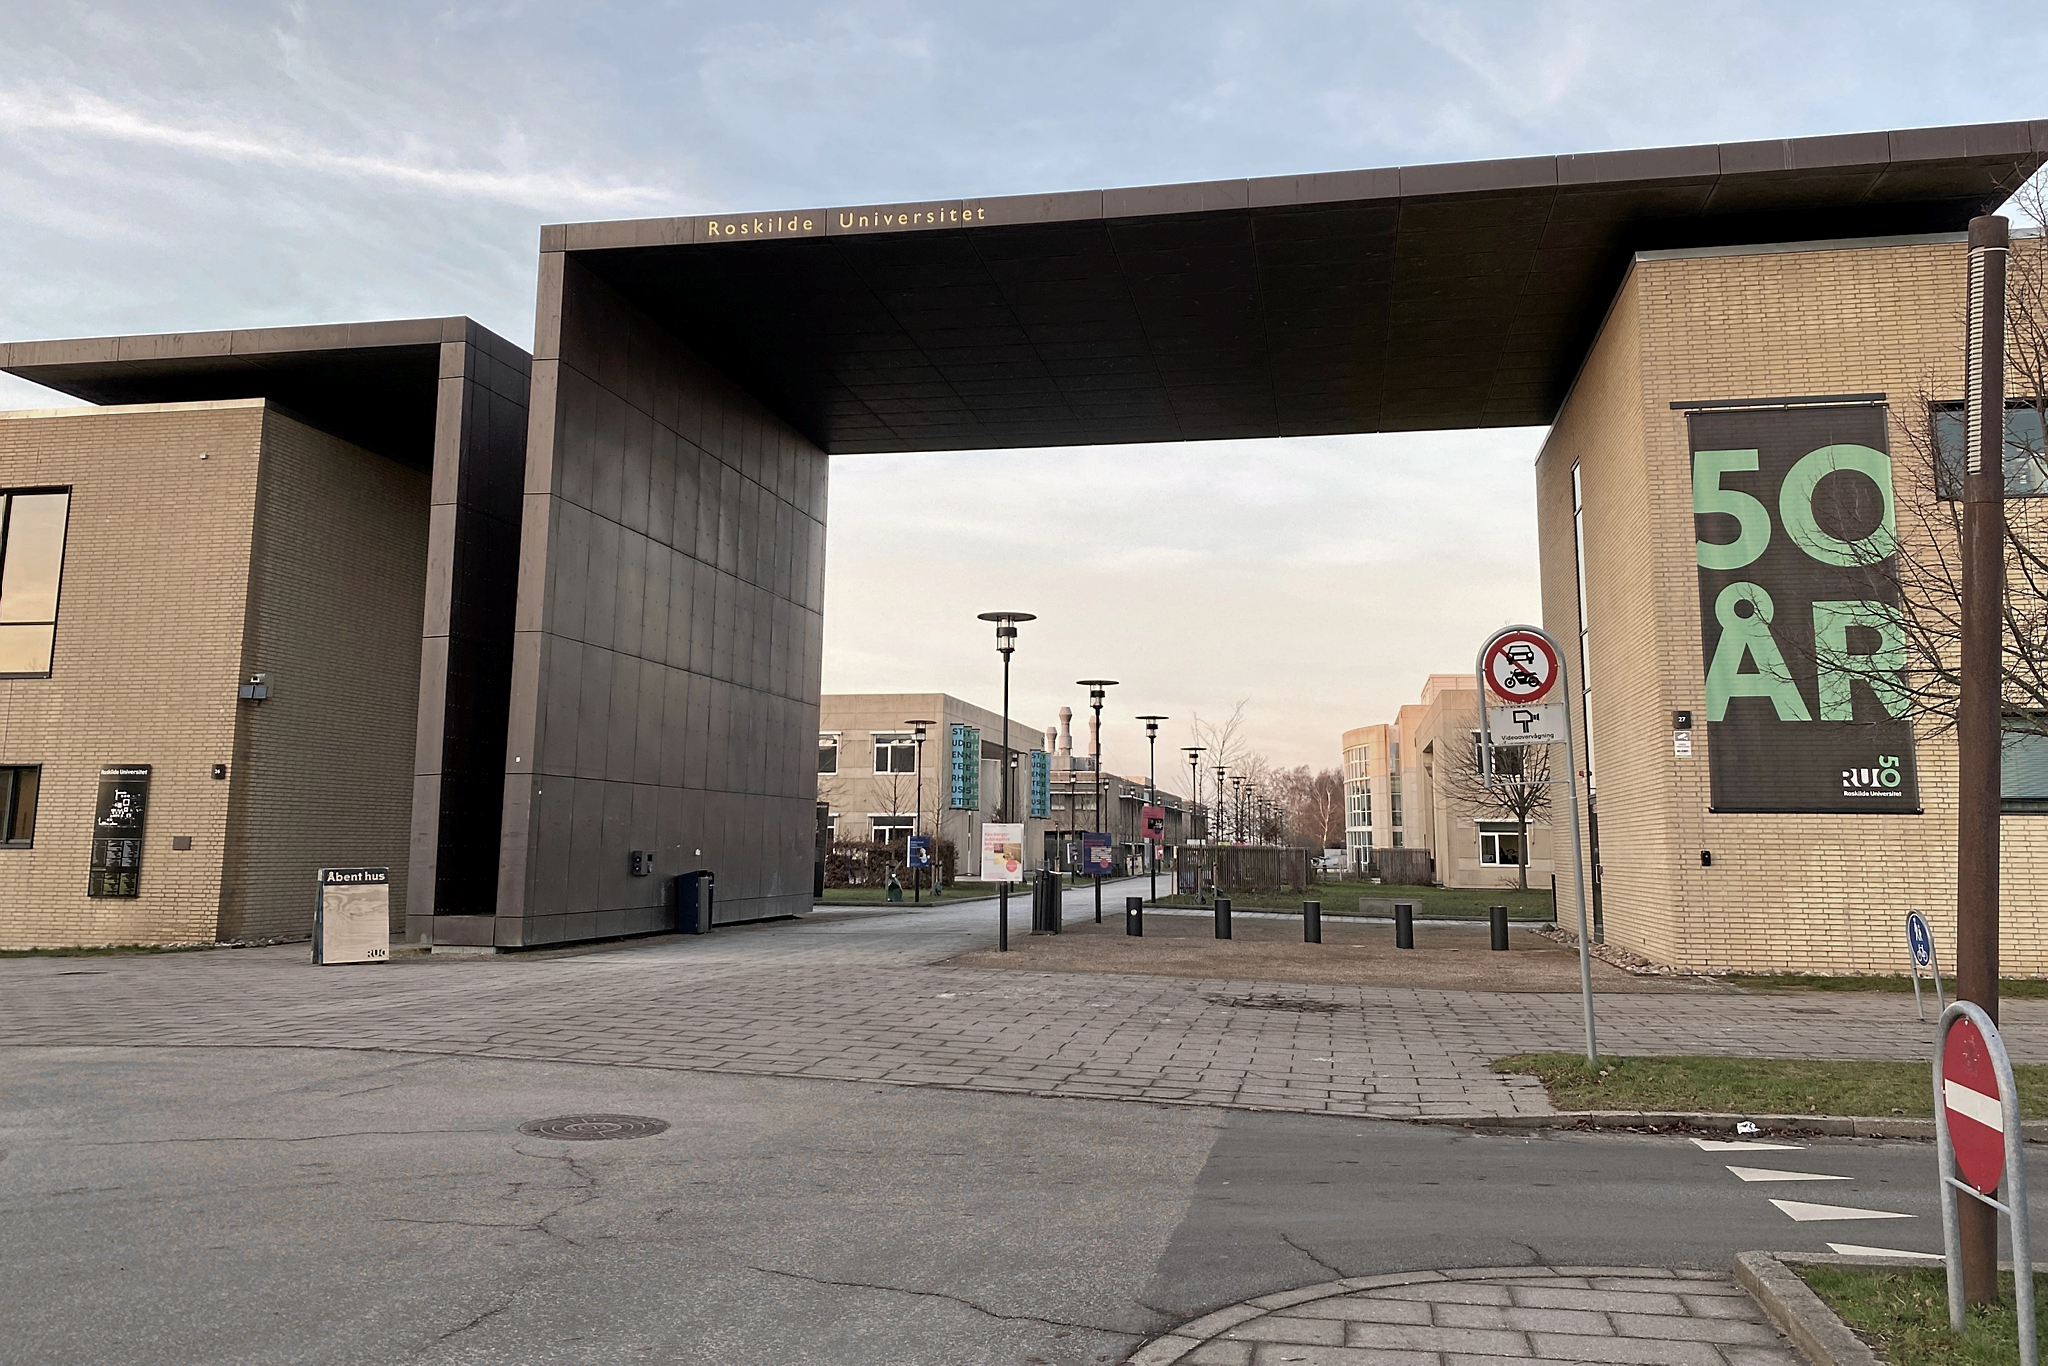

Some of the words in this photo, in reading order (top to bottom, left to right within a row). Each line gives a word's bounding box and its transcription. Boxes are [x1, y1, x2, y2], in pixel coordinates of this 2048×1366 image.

[708, 215, 813, 236] Roskilde
[839, 207, 985, 228] Universitet
[1693, 444, 1896, 570] 50
[1705, 582, 1914, 721] ÅR
[952, 728, 964, 736] ST
[952, 798, 963, 806] ET
[327, 872, 362, 882] Åbent
[364, 872, 386, 881] hus
